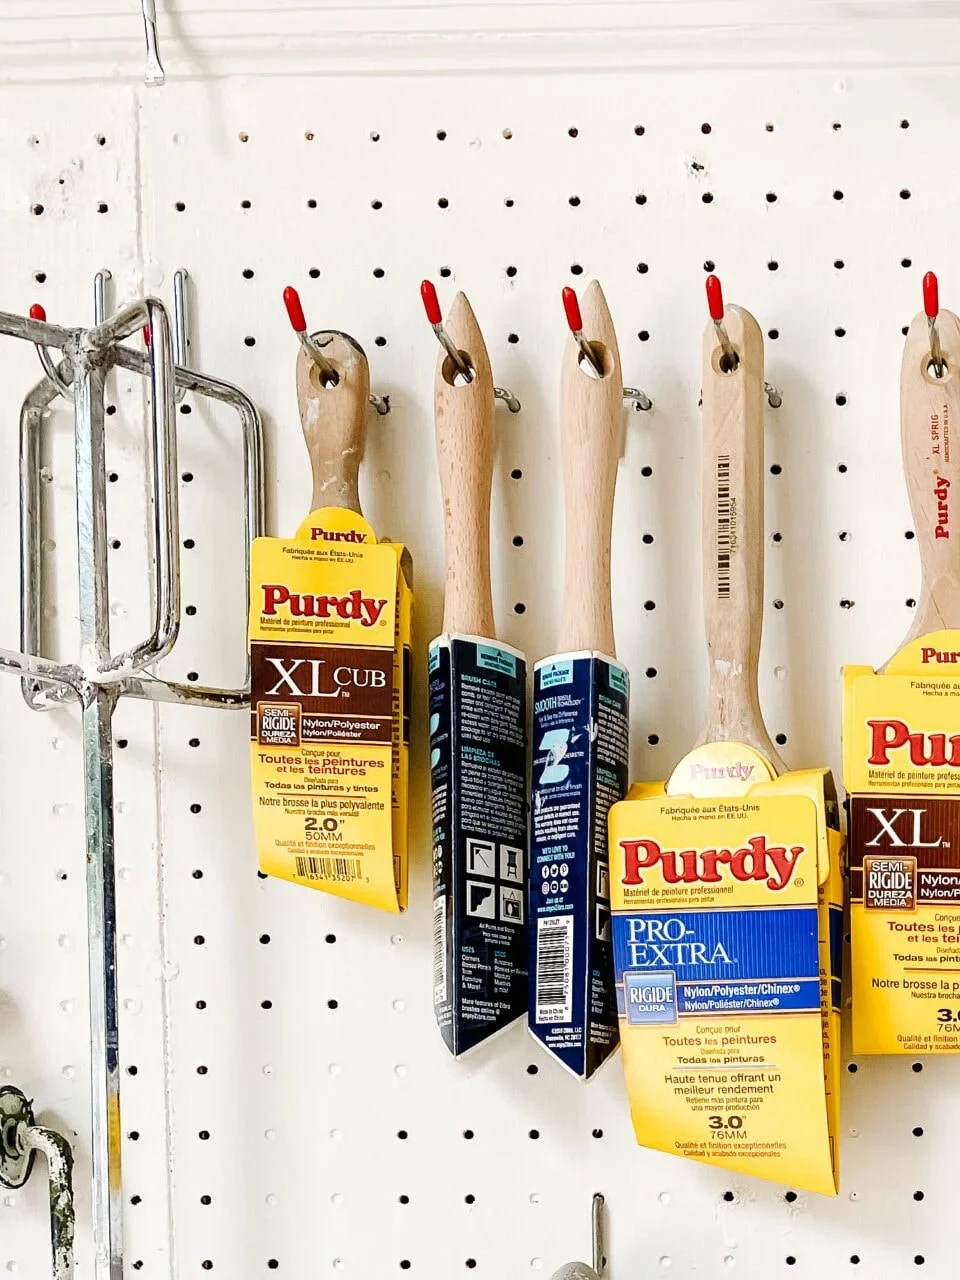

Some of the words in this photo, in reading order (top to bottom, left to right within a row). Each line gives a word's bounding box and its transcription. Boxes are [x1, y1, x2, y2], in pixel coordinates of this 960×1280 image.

[931, 414, 940, 440] SPRIG
[932, 444, 940, 454] XL
[934, 476, 951, 539] Purdy
[310, 527, 368, 544] Purdy
[261, 585, 388, 628] Purdy
[264, 658, 341, 698] XL
[333, 666, 386, 688] CUB
[910, 681, 951, 692] Fabriquée
[534, 696, 557, 714] SMOOTH
[264, 708, 293, 716] SEMI-
[262, 716, 296, 732] RIGIDE
[303, 719, 380, 730] Nylon/Polyester
[261, 730, 296, 738] DUREZA
[302, 730, 362, 738] Nylon/Poliéster
[258, 754, 302, 765] Toutes
[304, 758, 320, 766] les
[322, 758, 385, 768] peintures
[290, 766, 304, 774] les
[308, 766, 366, 776] teintures
[690, 762, 755, 782] Purdy
[868, 770, 896, 780] Matériel
[897, 770, 906, 779] de
[907, 771, 936, 782] peinture
[259, 796, 281, 807] Notre
[282, 798, 310, 808] brosse
[311, 798, 319, 808] la
[320, 800, 338, 811] plus
[339, 800, 385, 811] polyvalente
[660, 806, 700, 816] Fabriquée
[718, 804, 760, 812] États-Unis
[304, 817, 345, 832] 2.0"
[865, 807, 943, 848] XL
[305, 832, 343, 842] 50MM
[619, 836, 804, 890] Purdy
[872, 860, 908, 872] SEMI-
[869, 872, 912, 891] RIGIDE
[623, 888, 650, 898] Matériel
[652, 888, 660, 896] de
[662, 888, 688, 898] peinture
[690, 885, 734, 897] professionnel
[868, 890, 913, 899] DUREZA
[874, 898, 907, 906] MEDIA
[934, 913, 960, 924] Conçue
[626, 918, 695, 943] PRO-
[887, 921, 935, 932] Toutes
[938, 924, 955, 932] les
[907, 935, 920, 943] et
[922, 934, 939, 943] les
[628, 942, 734, 968] EXTRA
[872, 978, 900, 990] Notre
[902, 978, 938, 990] brosse
[940, 980, 950, 990] la
[630, 986, 674, 1003] RIGIDE
[638, 1004, 666, 1012] DURA
[696, 1026, 723, 1036] Conçue
[724, 1026, 741, 1036] pour
[662, 1036, 702, 1046] Toutes
[704, 1037, 718, 1046] les
[721, 1034, 777, 1048] peintures
[896, 1034, 922, 1044] Qualité
[933, 1034, 959, 1043] finition
[664, 1074, 696, 1084] Haute
[698, 1074, 728, 1083] tenue
[730, 1072, 765, 1084] offrant
[768, 1074, 782, 1082] un
[674, 1084, 715, 1095] meilleur
[718, 1084, 774, 1094] rendement
[710, 1130, 748, 1140] 76MM
